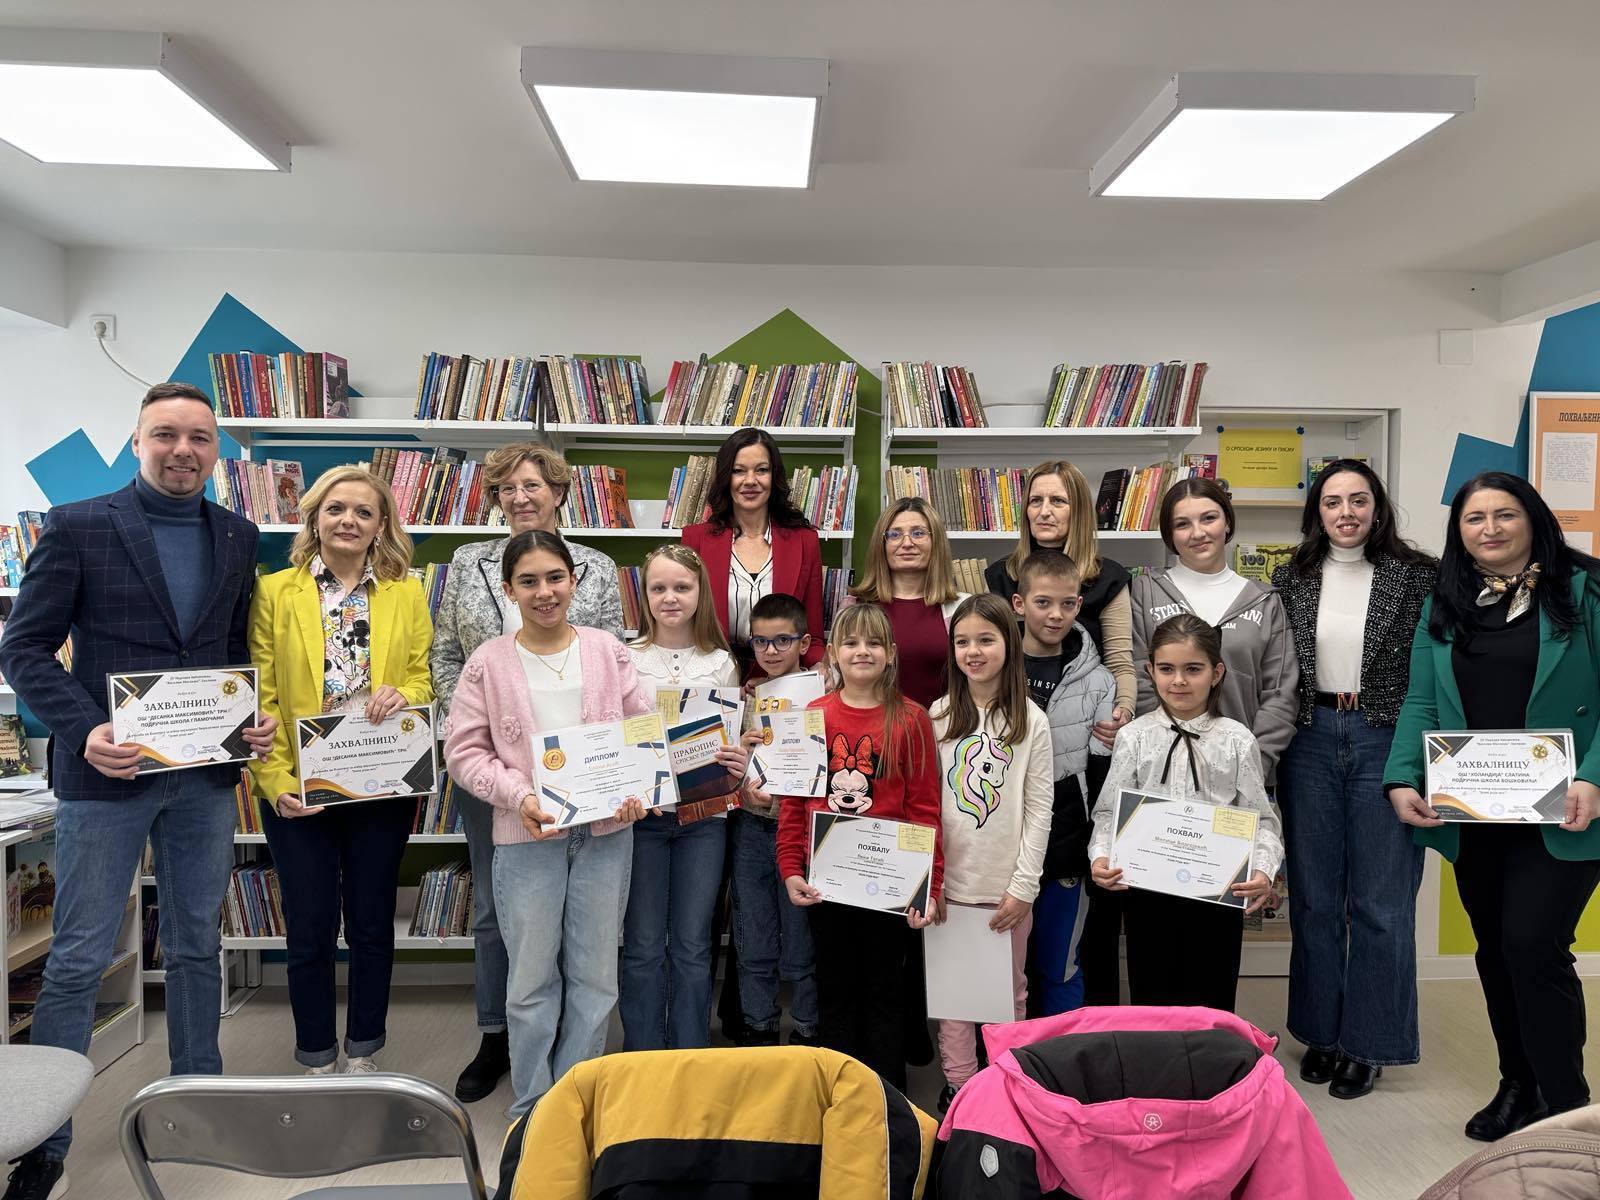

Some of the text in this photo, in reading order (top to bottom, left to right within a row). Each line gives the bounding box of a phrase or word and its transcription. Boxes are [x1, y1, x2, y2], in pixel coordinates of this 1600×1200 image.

[1240, 554, 1266, 566] 100
[143, 697, 220, 712] ЗАХВАЛНИЦУ
[328, 735, 399, 750] ЗАХВАЛНИЦУ
[673, 739, 719, 759] ПРАВОПИС
[584, 750, 620, 765] ДИПЛОМУ
[1456, 760, 1531, 770] ЗАХВАЛНИЦУ
[1166, 826, 1204, 840] ПОХВАЛУ
[857, 843, 890, 855] ПОХВАЛУ
